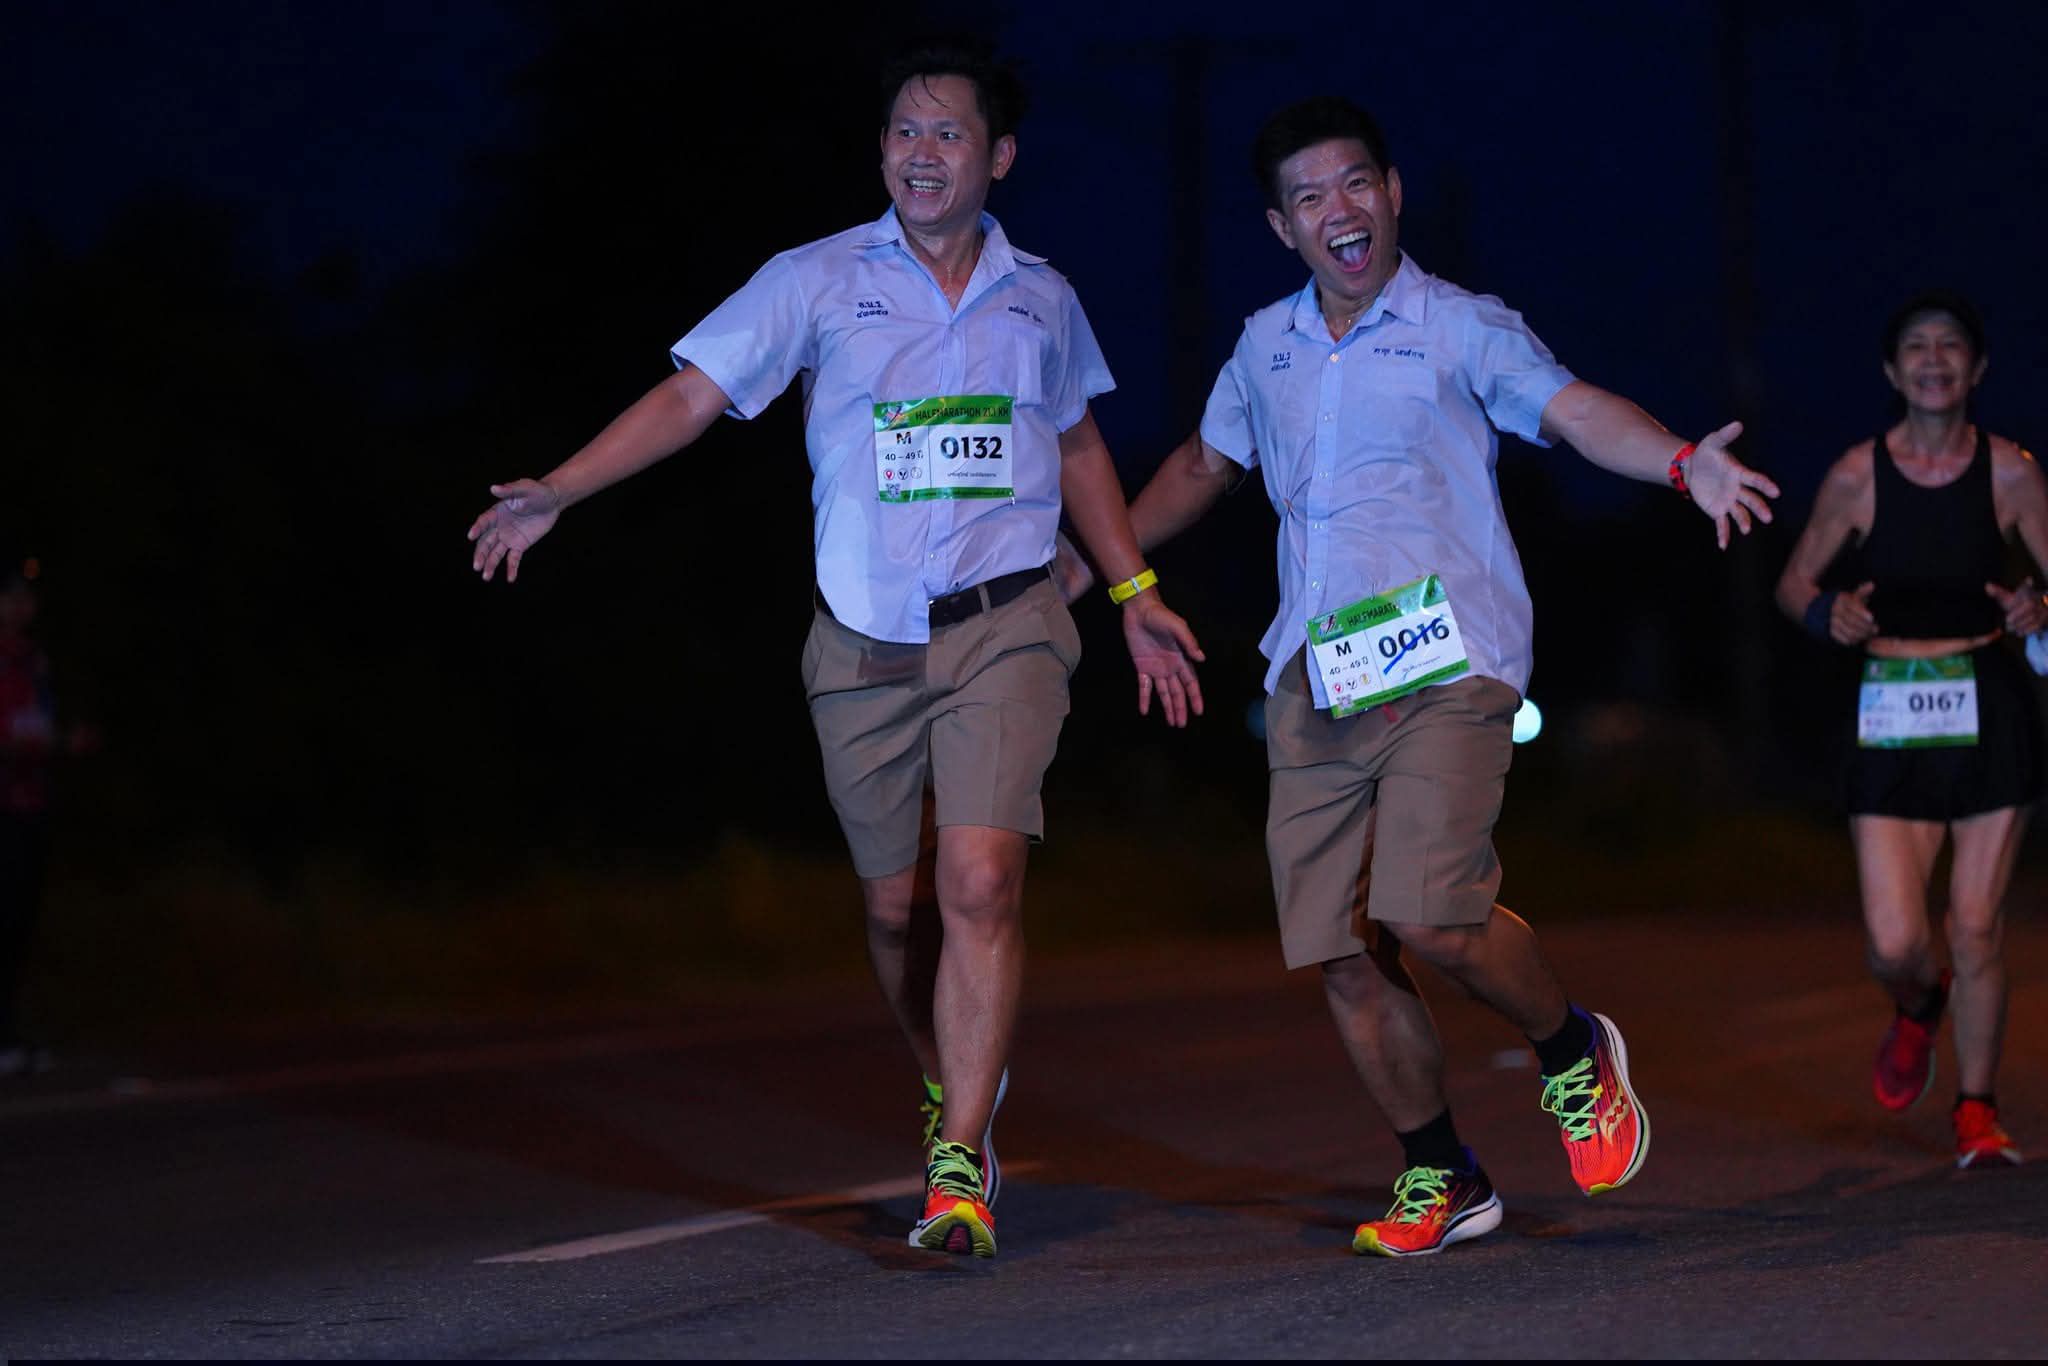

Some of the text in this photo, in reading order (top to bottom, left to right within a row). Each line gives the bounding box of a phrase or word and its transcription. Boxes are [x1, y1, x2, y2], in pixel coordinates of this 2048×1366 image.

[896, 431, 912, 445] M
[884, 453, 896, 461] 40
[905, 451, 916, 460] 49
[940, 436, 1003, 460] 0132
[1378, 616, 1450, 659] 0016
[1335, 641, 1353, 657] M
[1329, 665, 1341, 676] 40
[1349, 660, 1361, 670] 49
[1908, 690, 1966, 714] 0167
